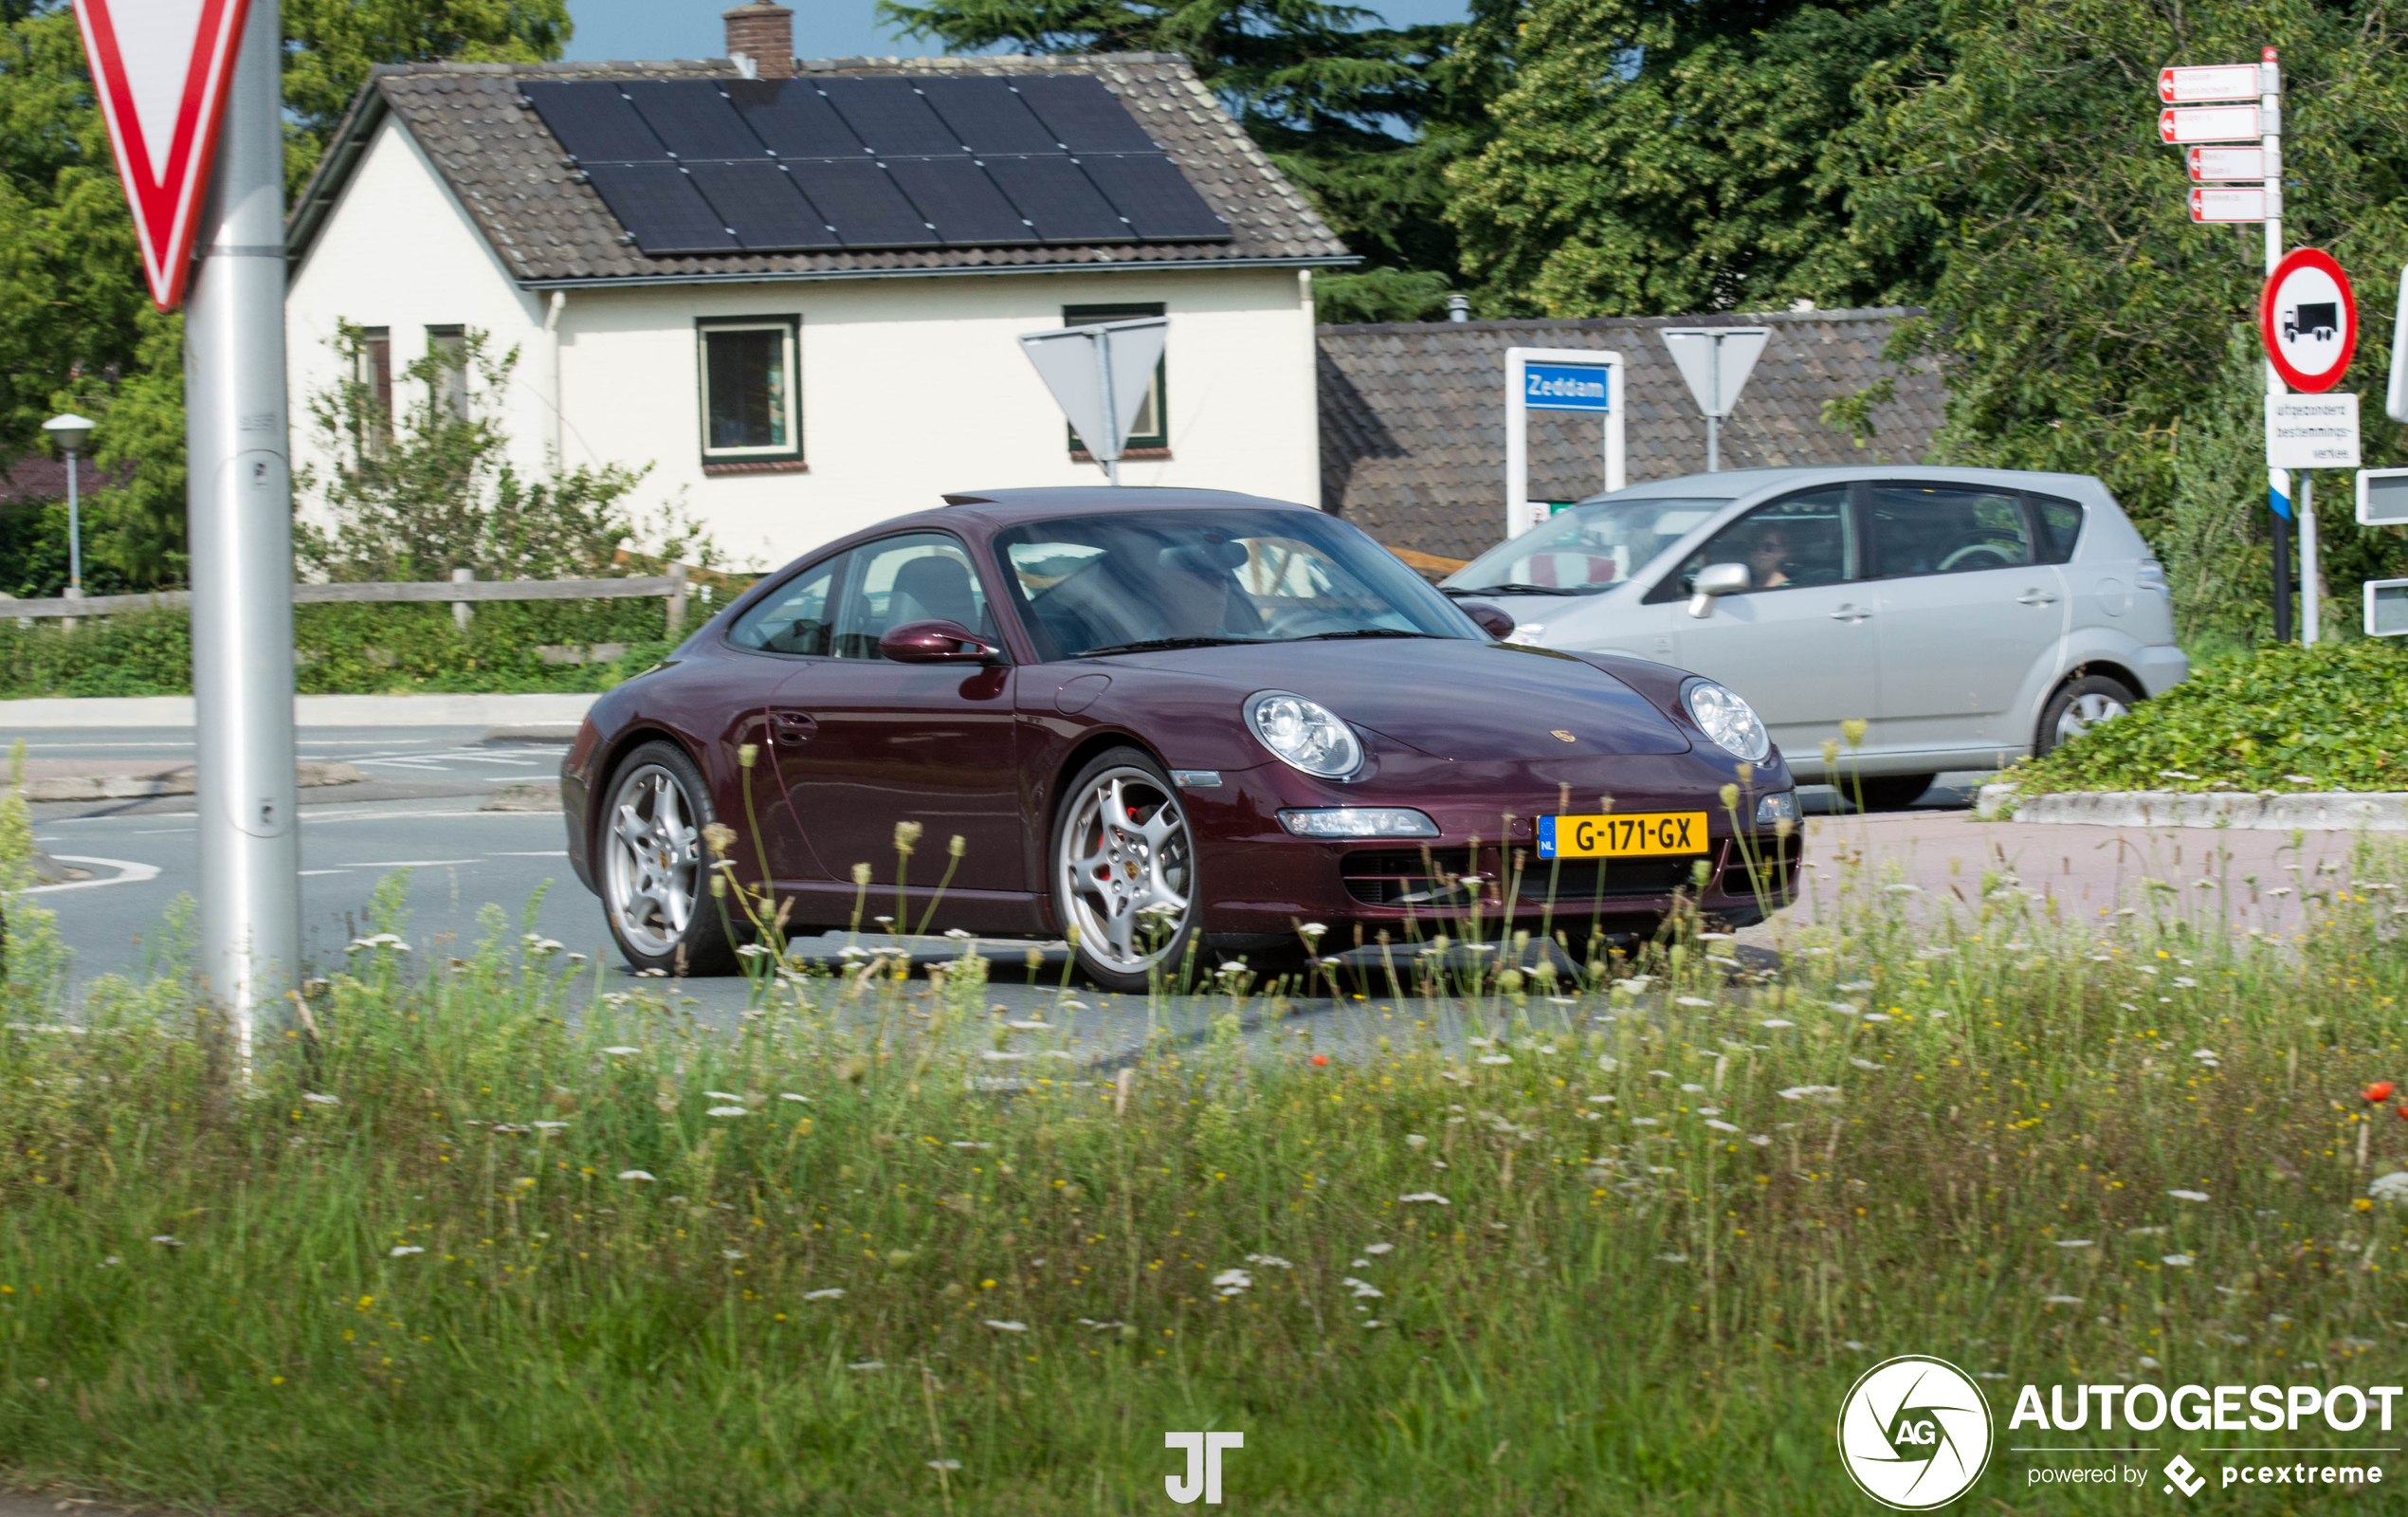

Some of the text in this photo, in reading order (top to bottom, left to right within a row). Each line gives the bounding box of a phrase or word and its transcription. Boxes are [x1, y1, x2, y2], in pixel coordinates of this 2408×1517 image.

[1527, 374, 1604, 398] Zeddam
[2313, 448, 2352, 459] verkee
[1576, 818, 1690, 850] G-171-GX
[1541, 841, 1554, 850] NL
